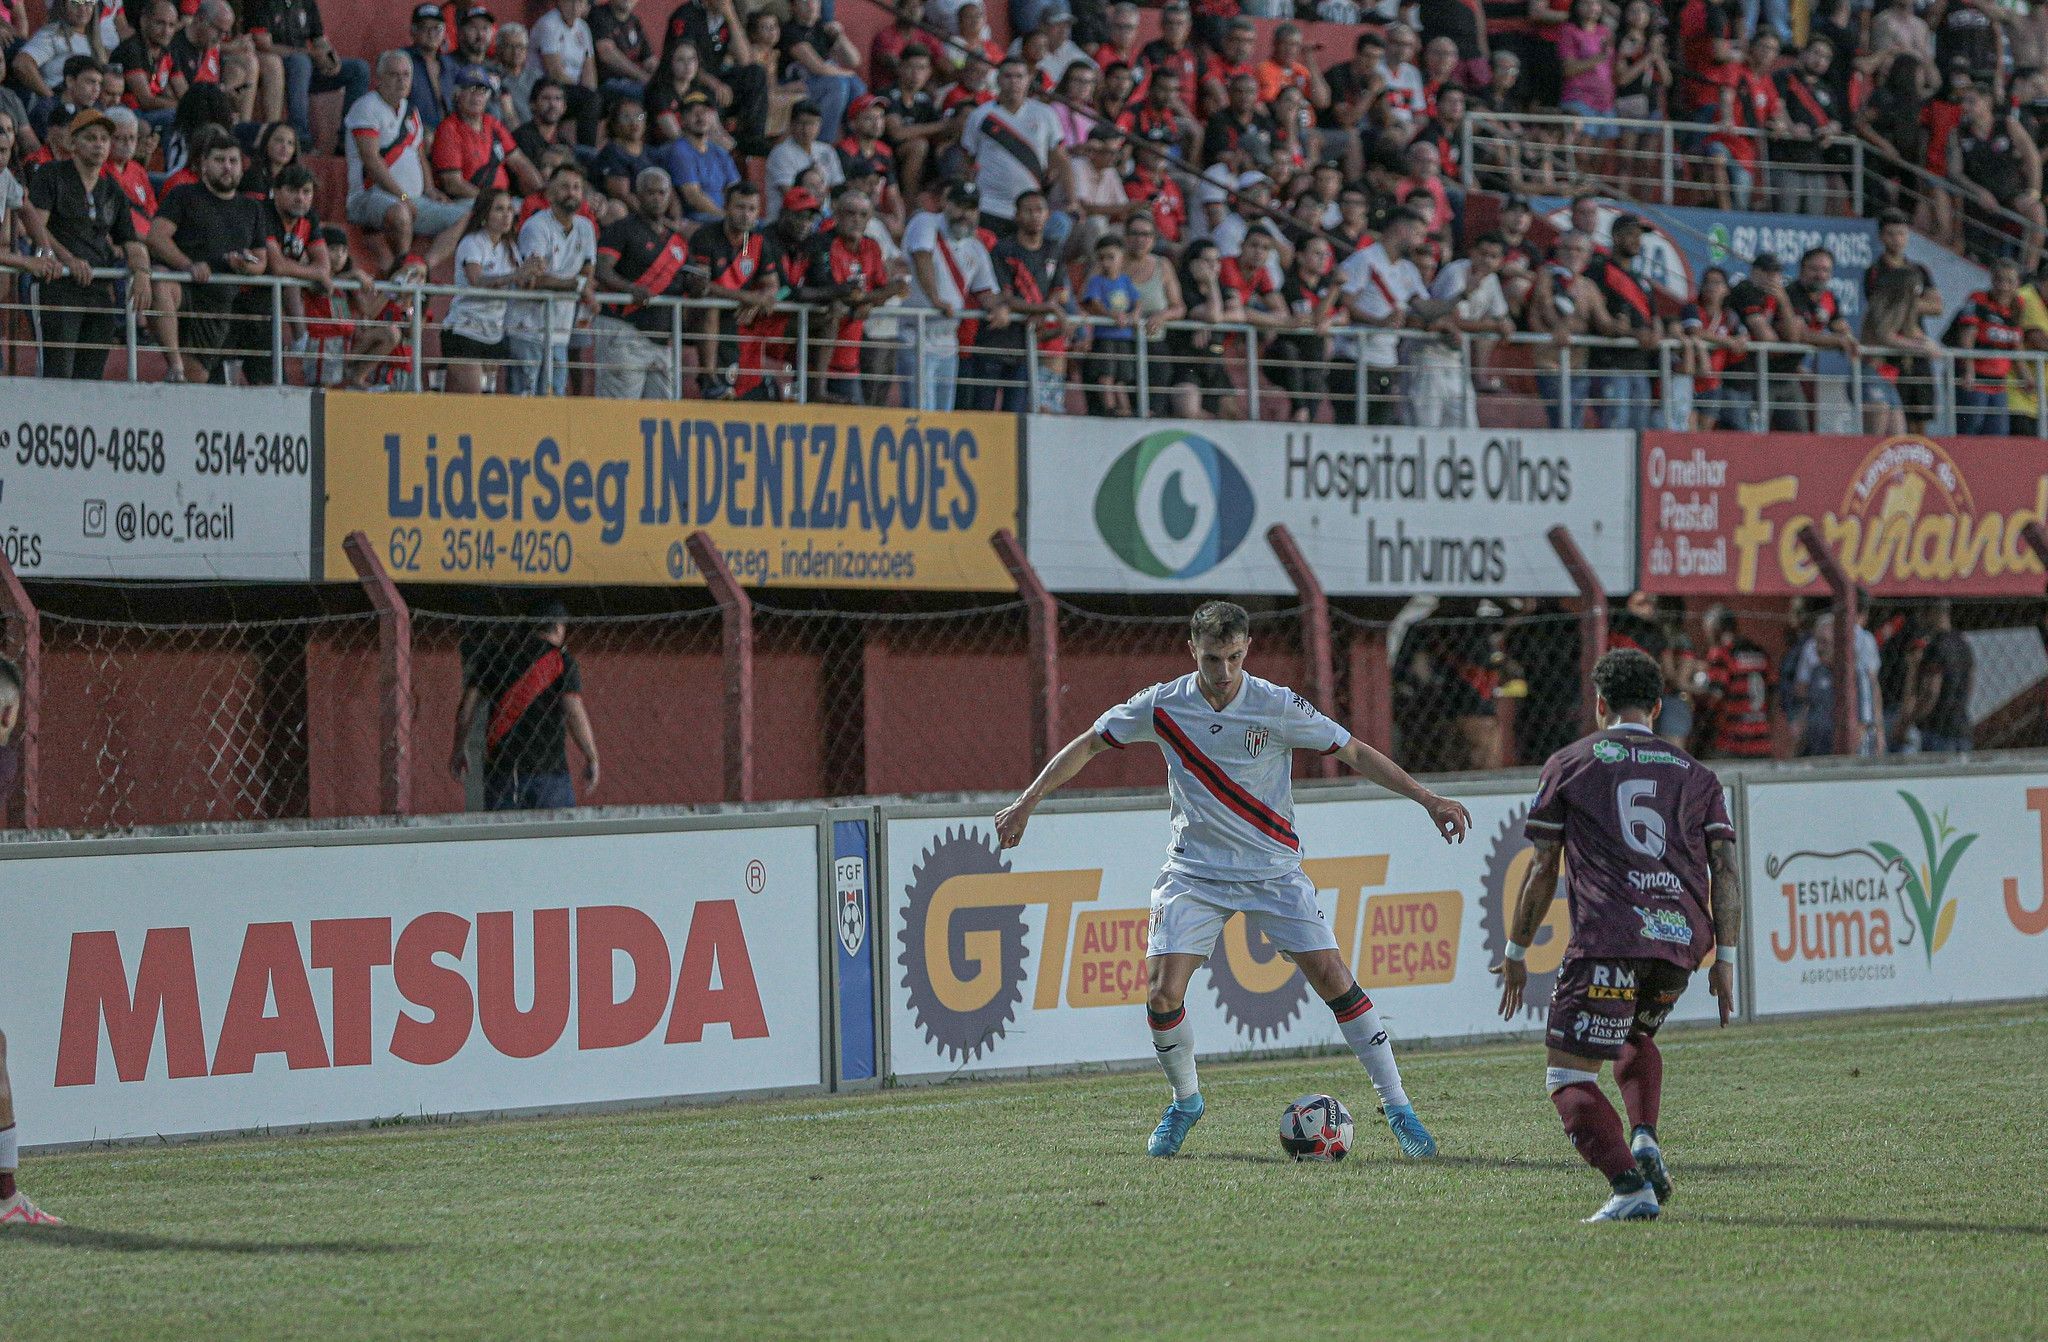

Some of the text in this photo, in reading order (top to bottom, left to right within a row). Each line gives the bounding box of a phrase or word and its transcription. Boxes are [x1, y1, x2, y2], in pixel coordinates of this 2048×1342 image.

[16, 421, 310, 475] 98590-4858 3514-3480
[1648, 446, 1728, 488] O melhor
[383, 416, 980, 546] LiderSeg INDENIZAÇÕES
[1284, 432, 1571, 515] Hospital de Olhos
[1660, 491, 1718, 531] Pastel
[389, 531, 574, 573] 62 3514-4250
[1367, 516, 1506, 583] Inhumas
[1676, 535, 1727, 576] Brasil
[1617, 779, 1666, 861] 6
[837, 864, 861, 881] FGF
[924, 868, 1103, 1012] GT
[1371, 903, 1438, 936] AUTO
[1771, 884, 1894, 963] Juma
[1083, 959, 1148, 1000] PEÇA
[1372, 940, 1451, 982] PEÇAS
[54, 899, 770, 1088] MATSUDA
